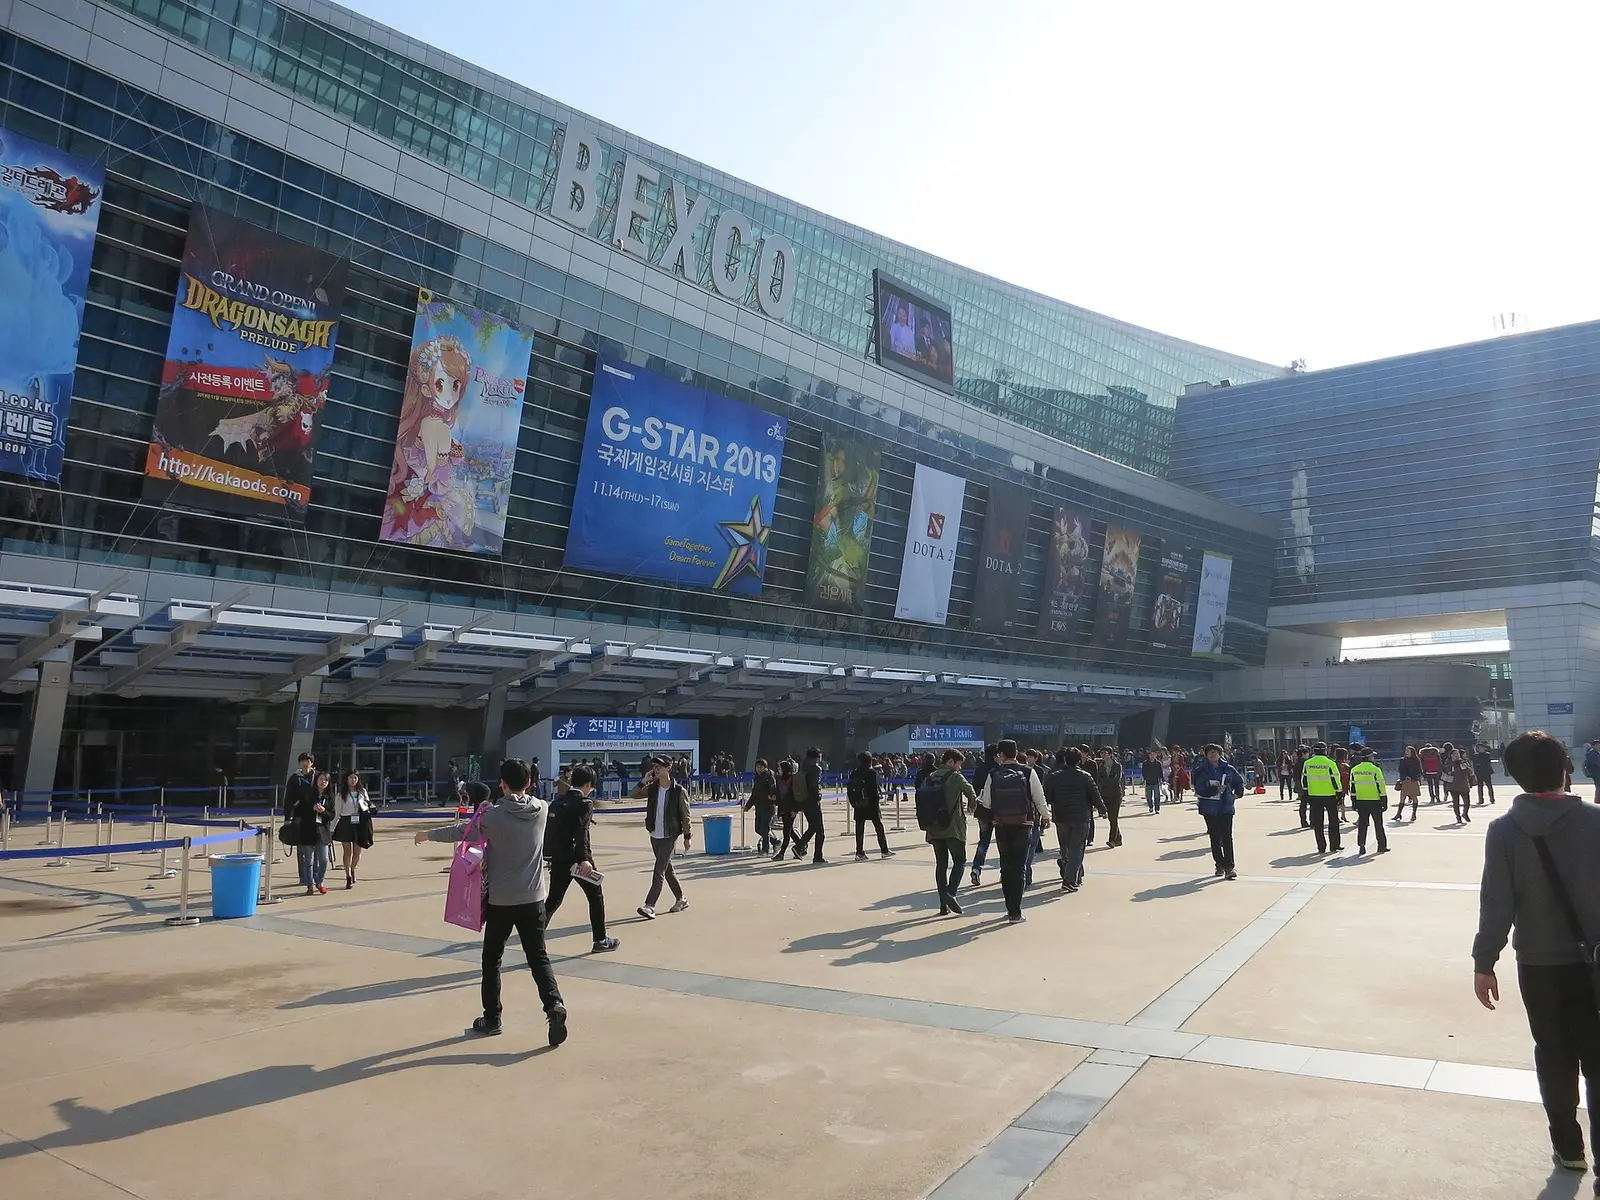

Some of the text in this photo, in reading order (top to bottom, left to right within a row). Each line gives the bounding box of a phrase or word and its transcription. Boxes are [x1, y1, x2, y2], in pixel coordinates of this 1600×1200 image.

[550, 121, 797, 321] BEXCO
[211, 270, 270, 302] GRAND
[240, 329, 298, 354] PRELUDE
[189, 371, 265, 392] 사전등록 이벤트
[602, 405, 777, 483] G-STAR 2013
[158, 452, 302, 501] http://kakaods.com
[597, 442, 735, 497] 국제게임전시회 지스타
[669, 550, 717, 568] Dream Forever
[913, 541, 954, 562] DOTA 2
[985, 556, 1022, 575] DOTA 2
[303, 713, 310, 729] 1
[588, 718, 670, 733] 초대권 온라인예매
[953, 728, 973, 738] Tickets
